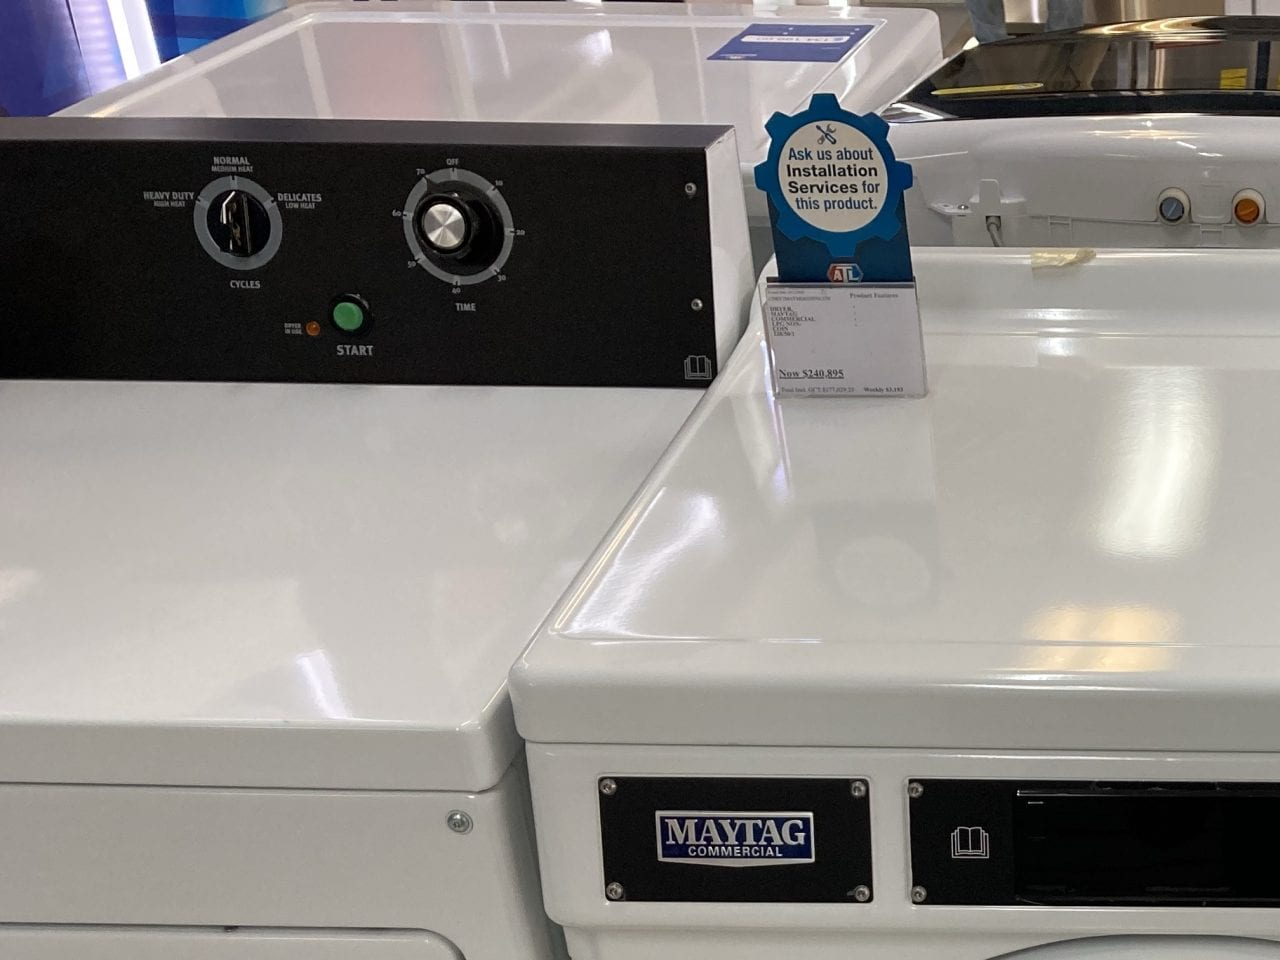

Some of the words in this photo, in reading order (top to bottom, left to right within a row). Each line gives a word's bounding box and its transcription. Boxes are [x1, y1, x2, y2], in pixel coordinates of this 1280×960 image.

[788, 147, 813, 161] Ask
[817, 150, 832, 161] us
[836, 147, 874, 161] about
[213, 156, 250, 165] NORMAL
[446, 158, 459, 166] OFF
[786, 164, 878, 177] Installation
[788, 181, 858, 194] Services
[862, 181, 880, 193] for
[143, 191, 171, 200] HEAVY
[172, 191, 195, 200] DUTY
[277, 193, 322, 202] DELICATES
[795, 197, 820, 210] this
[824, 197, 877, 212] product.
[833, 266, 860, 282] ATL
[230, 280, 261, 289] CYCLES
[455, 303, 476, 312] TIME
[336, 345, 373, 356] START
[779, 369, 800, 379] Now
[802, 368, 844, 379] $240,895
[664, 818, 806, 846] MAYTAG
[688, 846, 783, 857] COMMERCIAL
